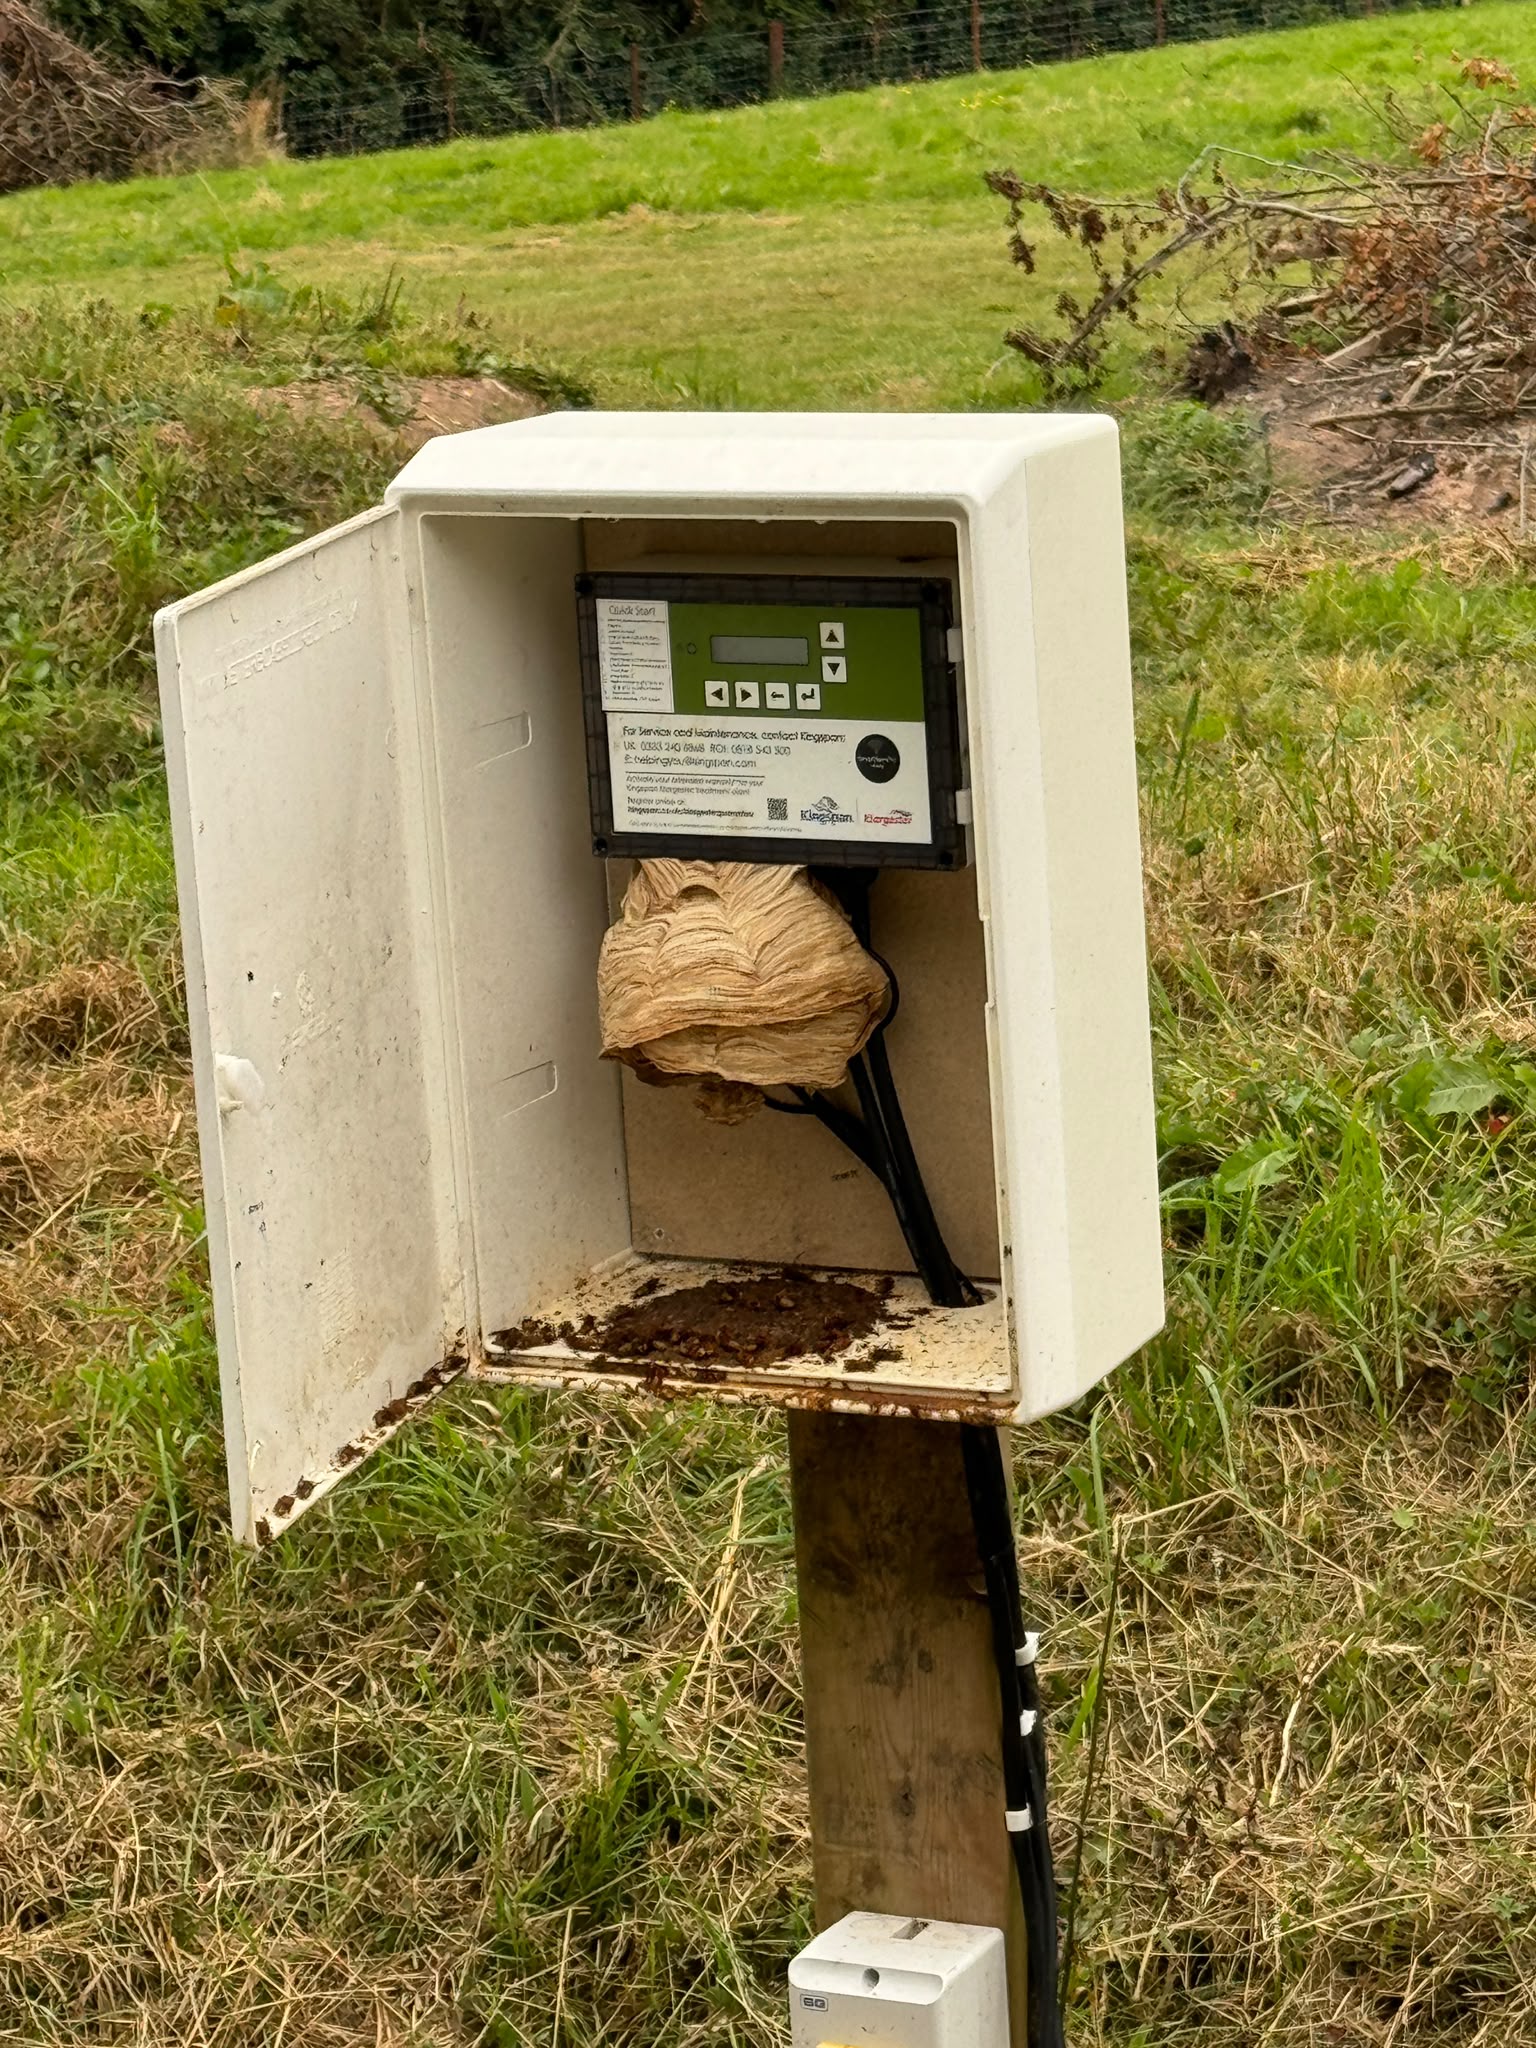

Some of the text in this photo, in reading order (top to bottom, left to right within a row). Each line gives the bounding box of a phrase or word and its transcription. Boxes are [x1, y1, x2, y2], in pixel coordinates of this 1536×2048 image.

[623, 725, 636, 737] For
[638, 726, 671, 738] Service
[761, 730, 799, 741] contact
